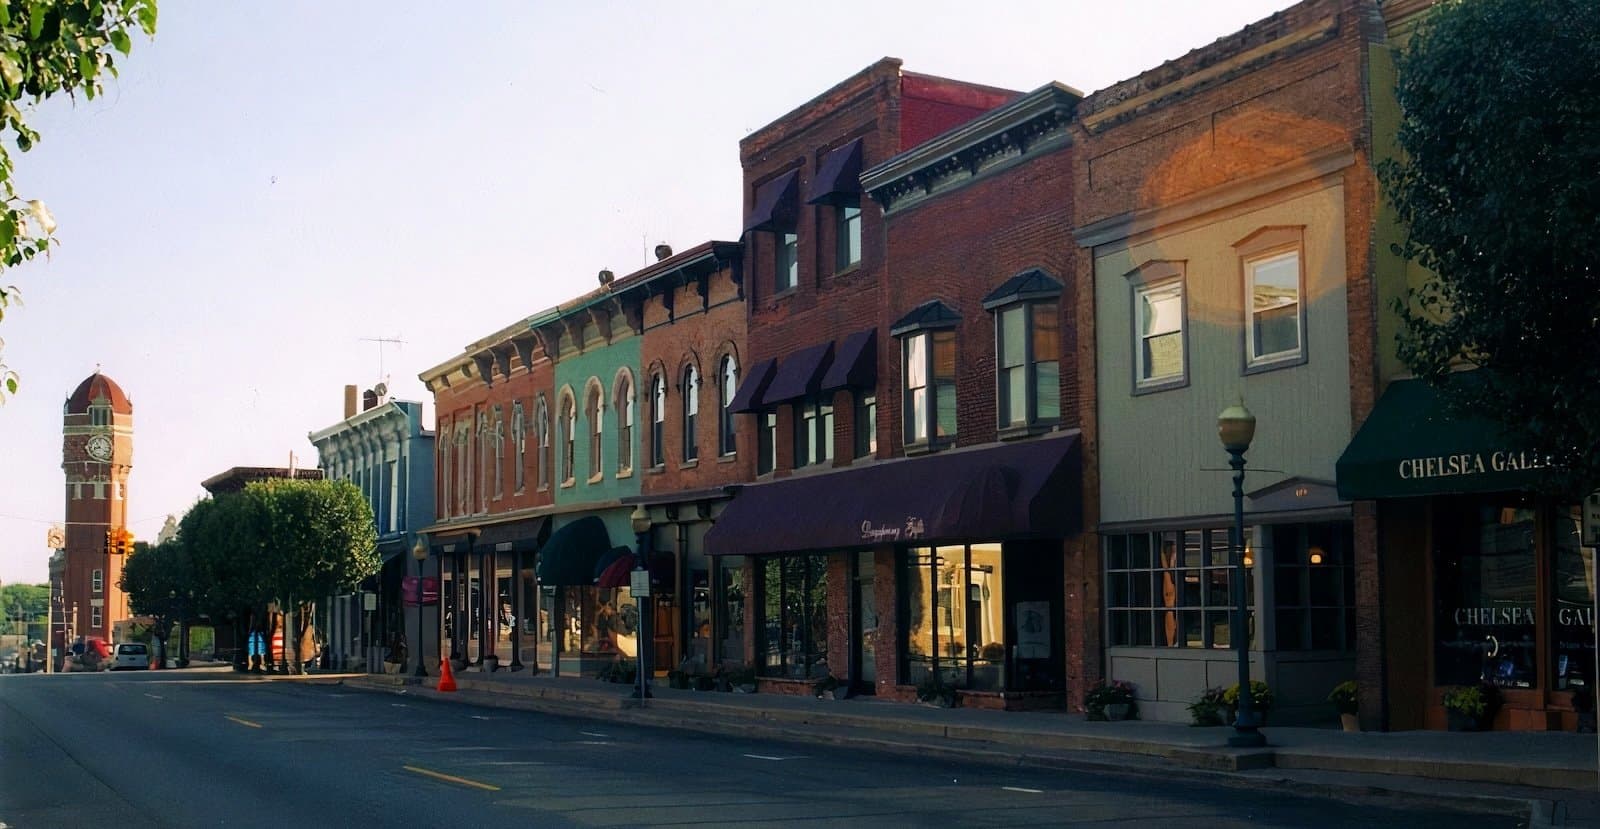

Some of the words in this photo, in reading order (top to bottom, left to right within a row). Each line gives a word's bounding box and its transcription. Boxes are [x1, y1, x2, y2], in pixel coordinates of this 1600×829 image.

[1399, 453, 1486, 480] CHELSEA
[1491, 449, 1567, 473] GALL
[1454, 607, 1536, 626] CHELSEA
